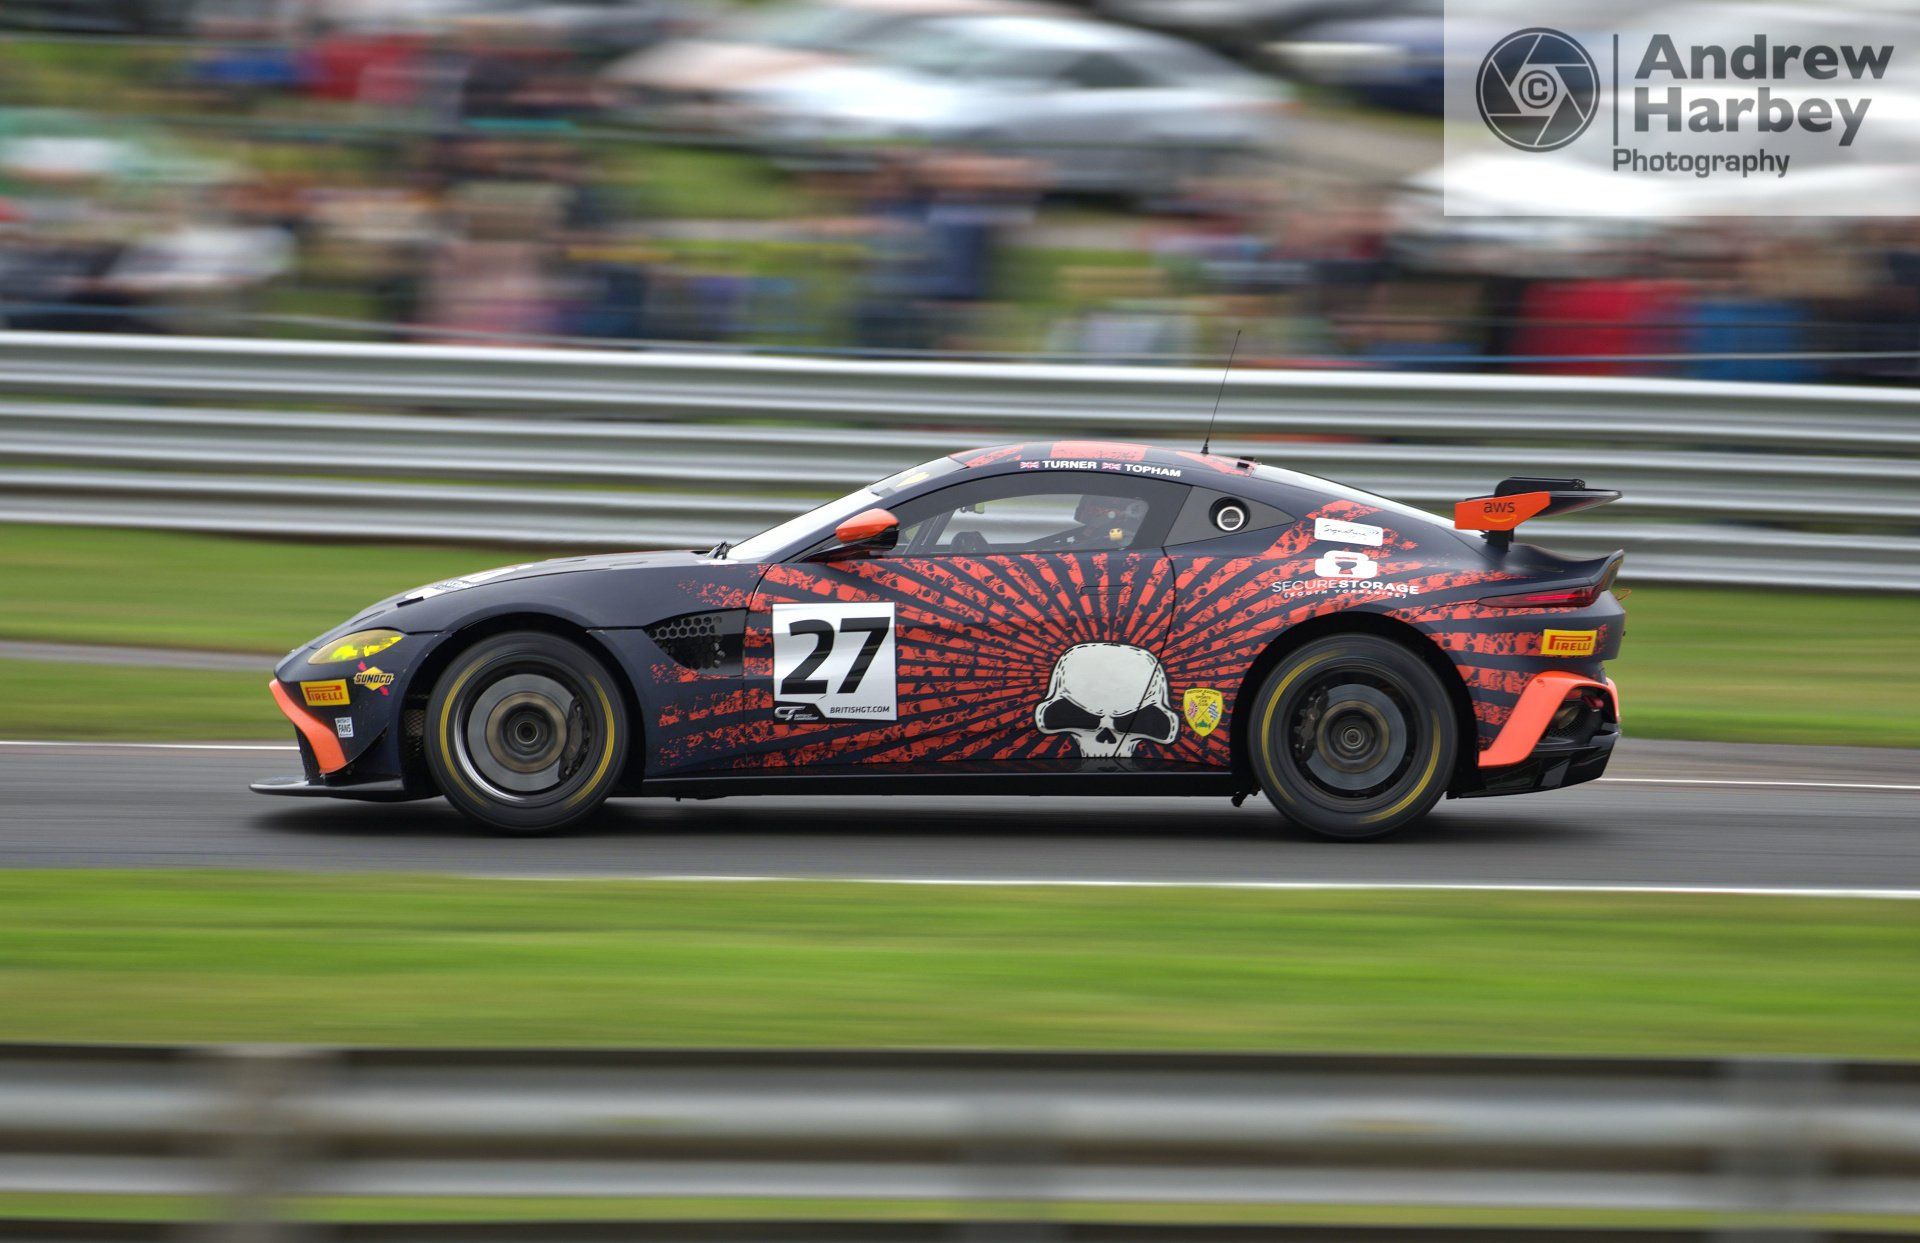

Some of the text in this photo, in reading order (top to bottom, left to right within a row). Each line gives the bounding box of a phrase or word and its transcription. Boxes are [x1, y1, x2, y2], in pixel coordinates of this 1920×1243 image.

[1042, 460, 1182, 478] TURNER TOPHAM
[1483, 502, 1516, 513] aws
[1548, 635, 1593, 651] PIRELLI
[780, 616, 891, 695] 27
[355, 674, 392, 684] SUNOCO
[305, 685, 344, 702] PIRELLI
[829, 705, 890, 714] BRITISHGT.COM
